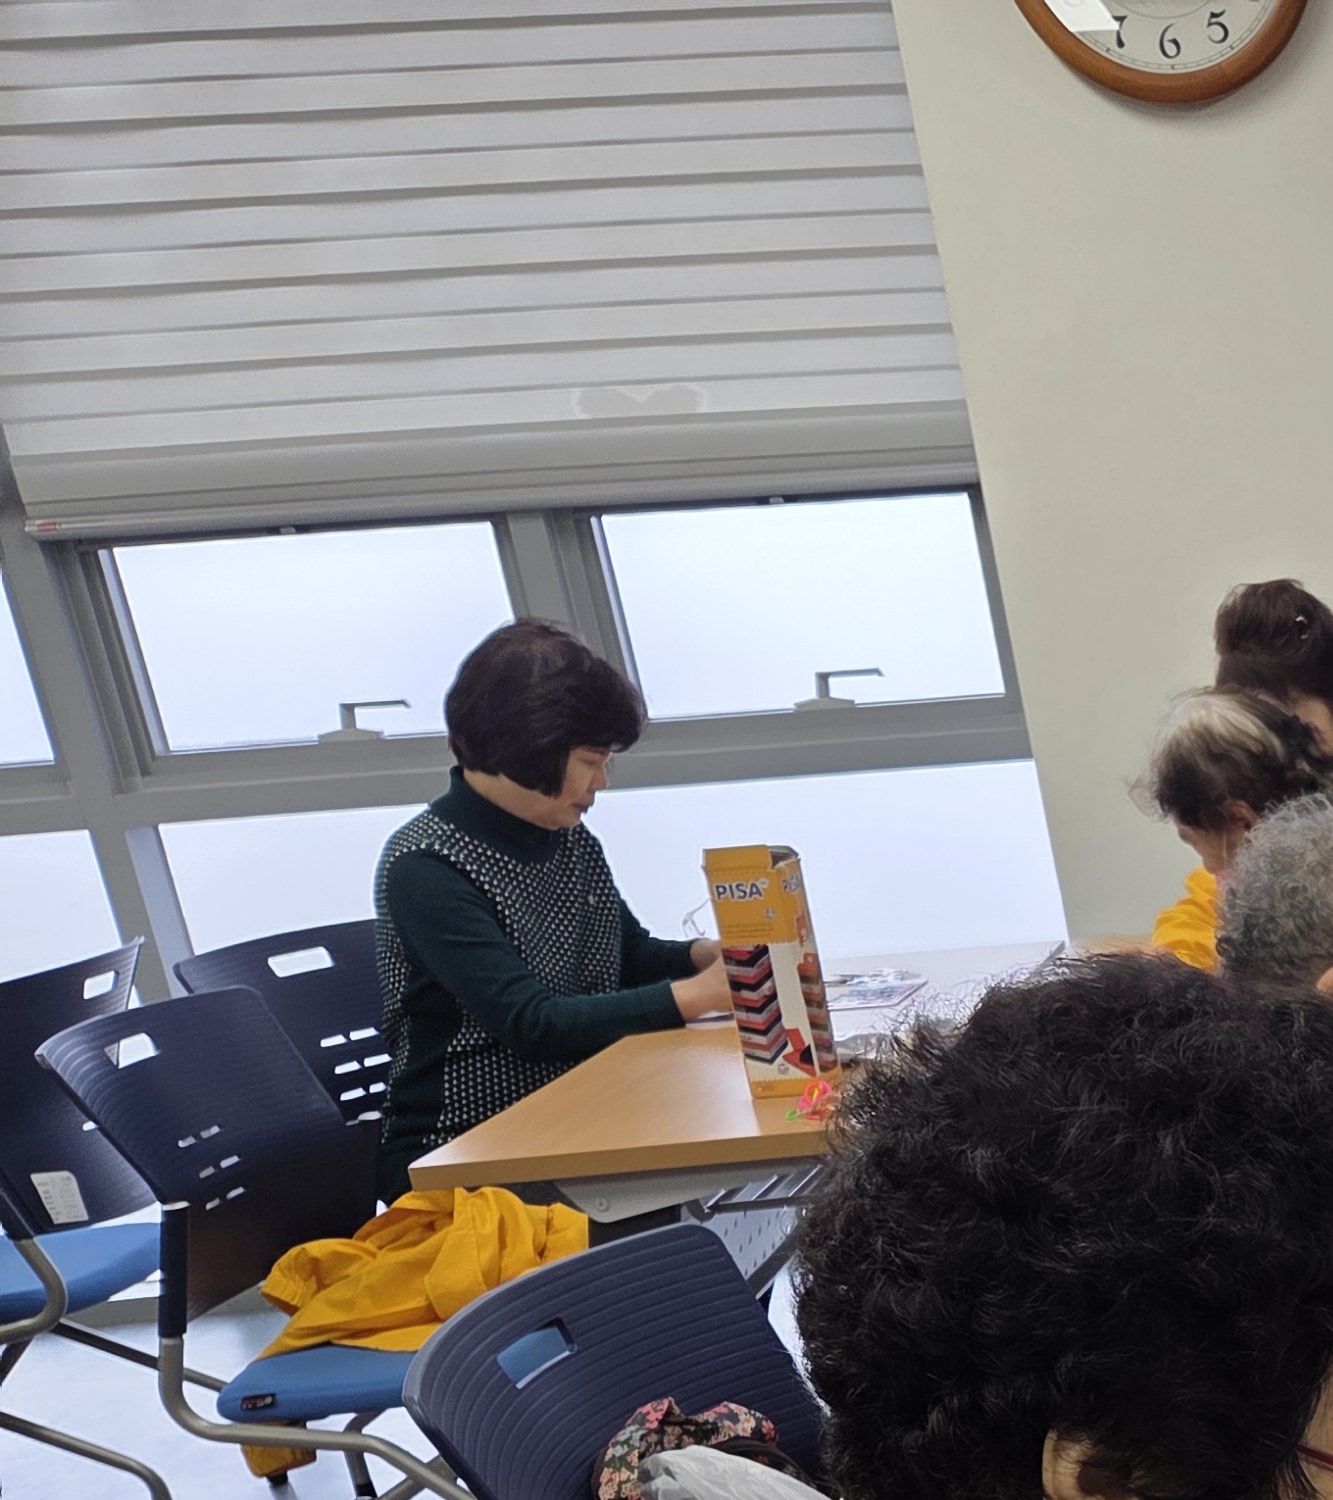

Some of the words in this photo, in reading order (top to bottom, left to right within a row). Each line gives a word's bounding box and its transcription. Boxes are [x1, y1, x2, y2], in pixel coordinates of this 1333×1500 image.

[1159, 23, 1182, 60] 6
[1205, 9, 1230, 45] 5
[715, 882, 763, 900] PISA
